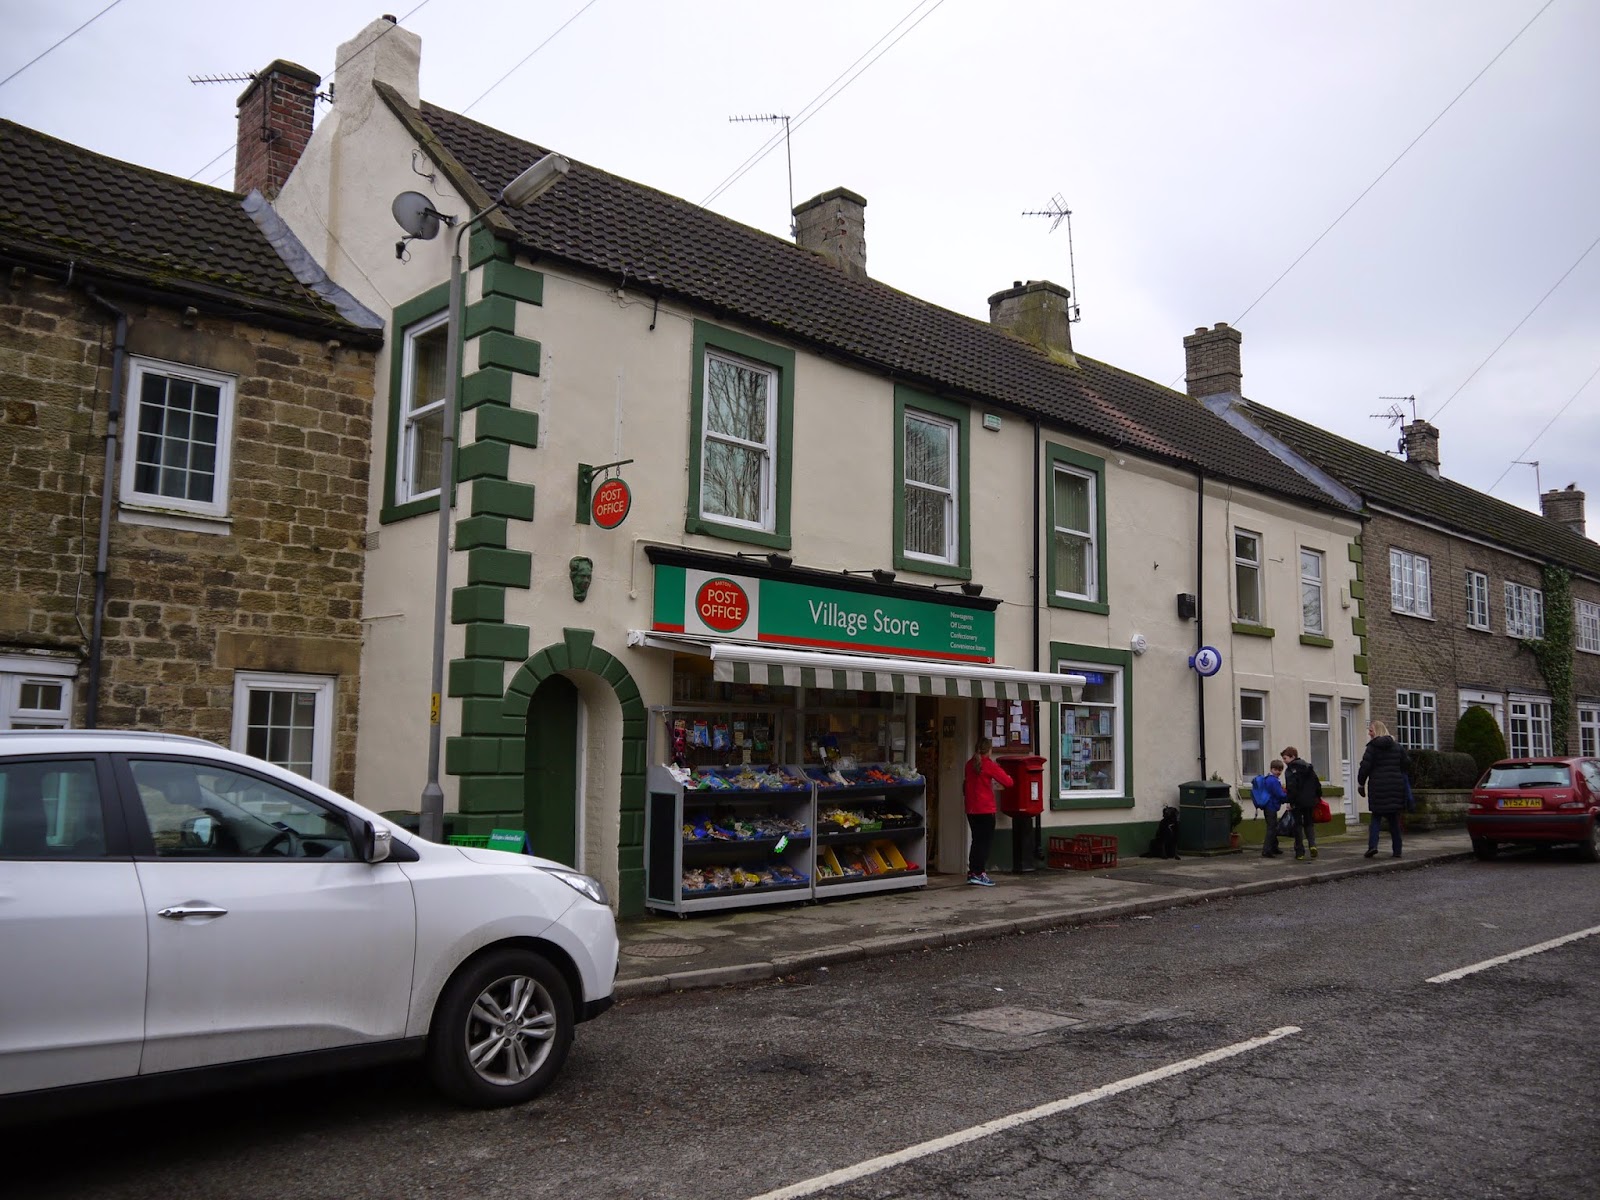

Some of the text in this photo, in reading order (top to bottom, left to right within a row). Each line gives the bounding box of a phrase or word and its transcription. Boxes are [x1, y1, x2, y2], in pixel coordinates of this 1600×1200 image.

[600, 488, 622, 502] POST
[596, 500, 624, 516] OFFICE
[707, 589, 739, 604] POST
[701, 603, 742, 620] OFFICE
[808, 600, 920, 637] Village Store
[950, 611, 974, 621] Newsagents
[950, 631, 978, 642] Confectionery
[950, 642, 975, 650] Convenience
